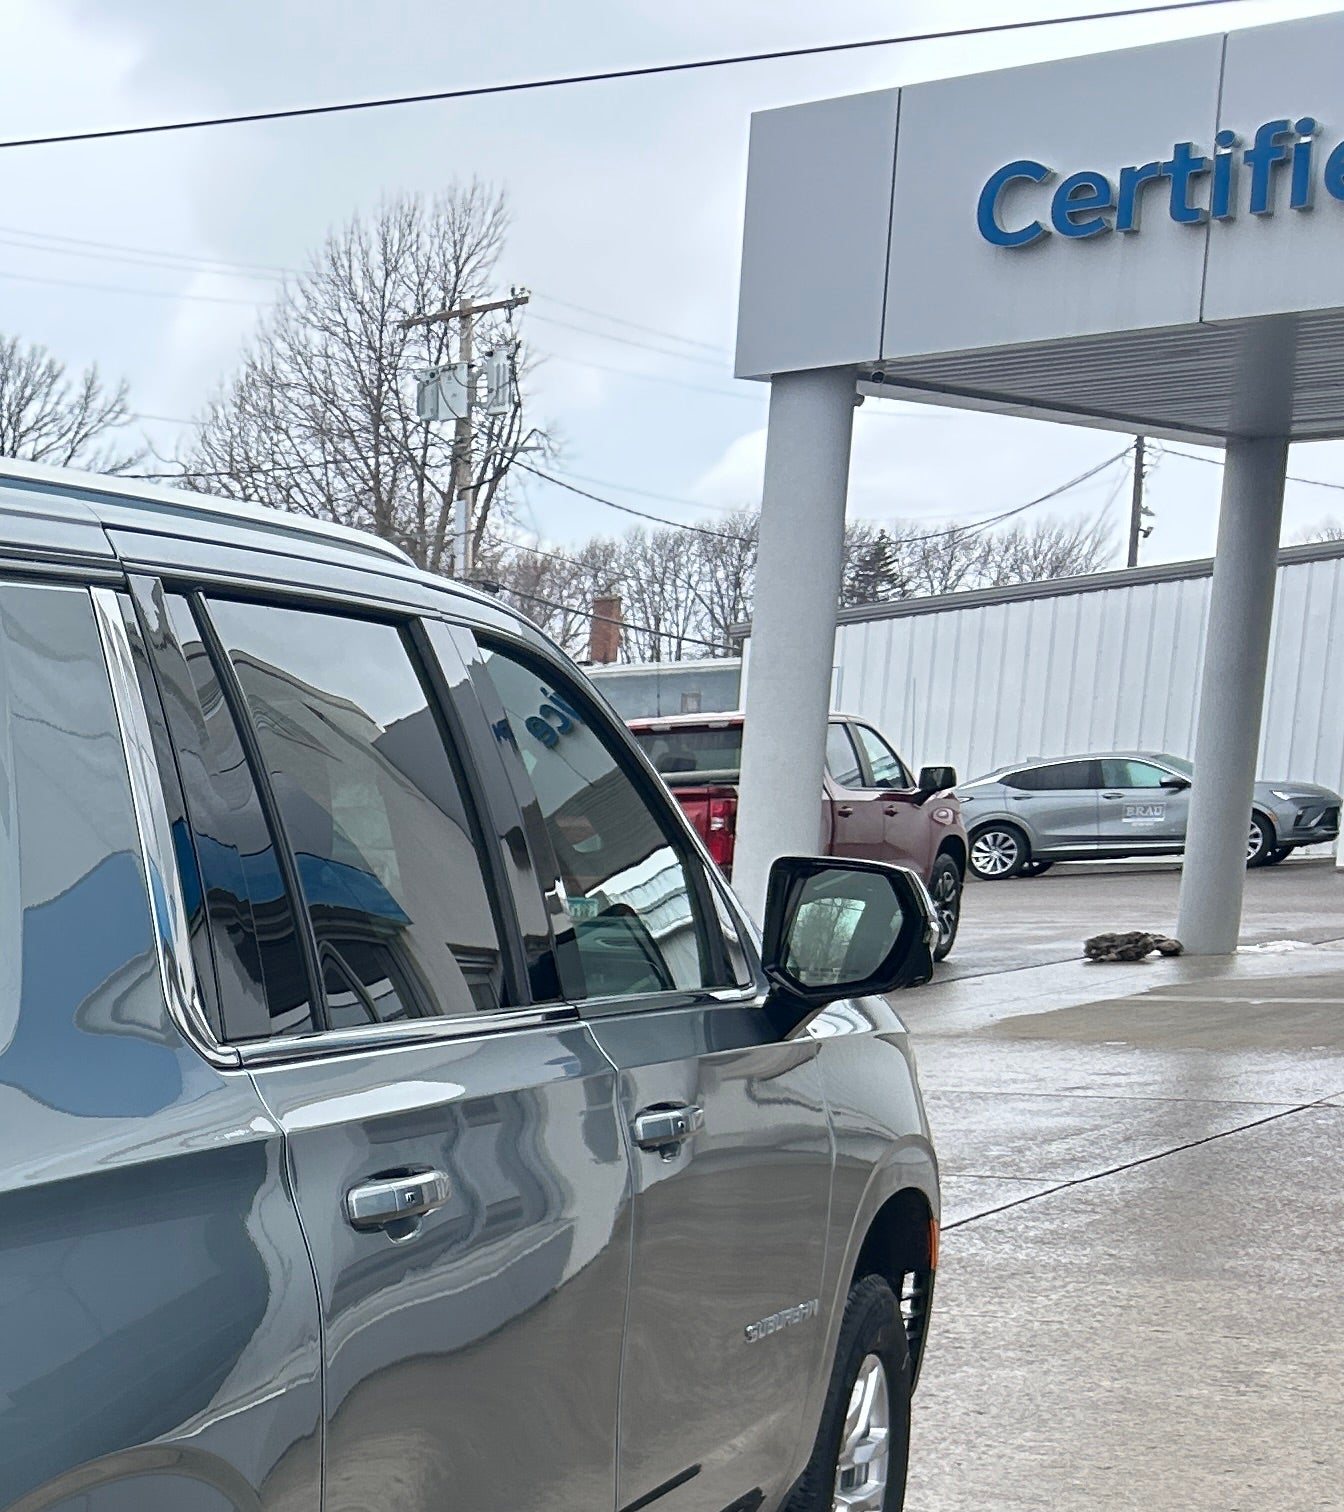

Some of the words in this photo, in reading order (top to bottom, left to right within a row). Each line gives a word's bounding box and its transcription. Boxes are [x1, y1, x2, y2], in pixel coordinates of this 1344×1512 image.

[977, 116, 1344, 249] Certifi
[1126, 805, 1163, 817] BRAU
[744, 1299, 819, 1343] SUBURBAN
